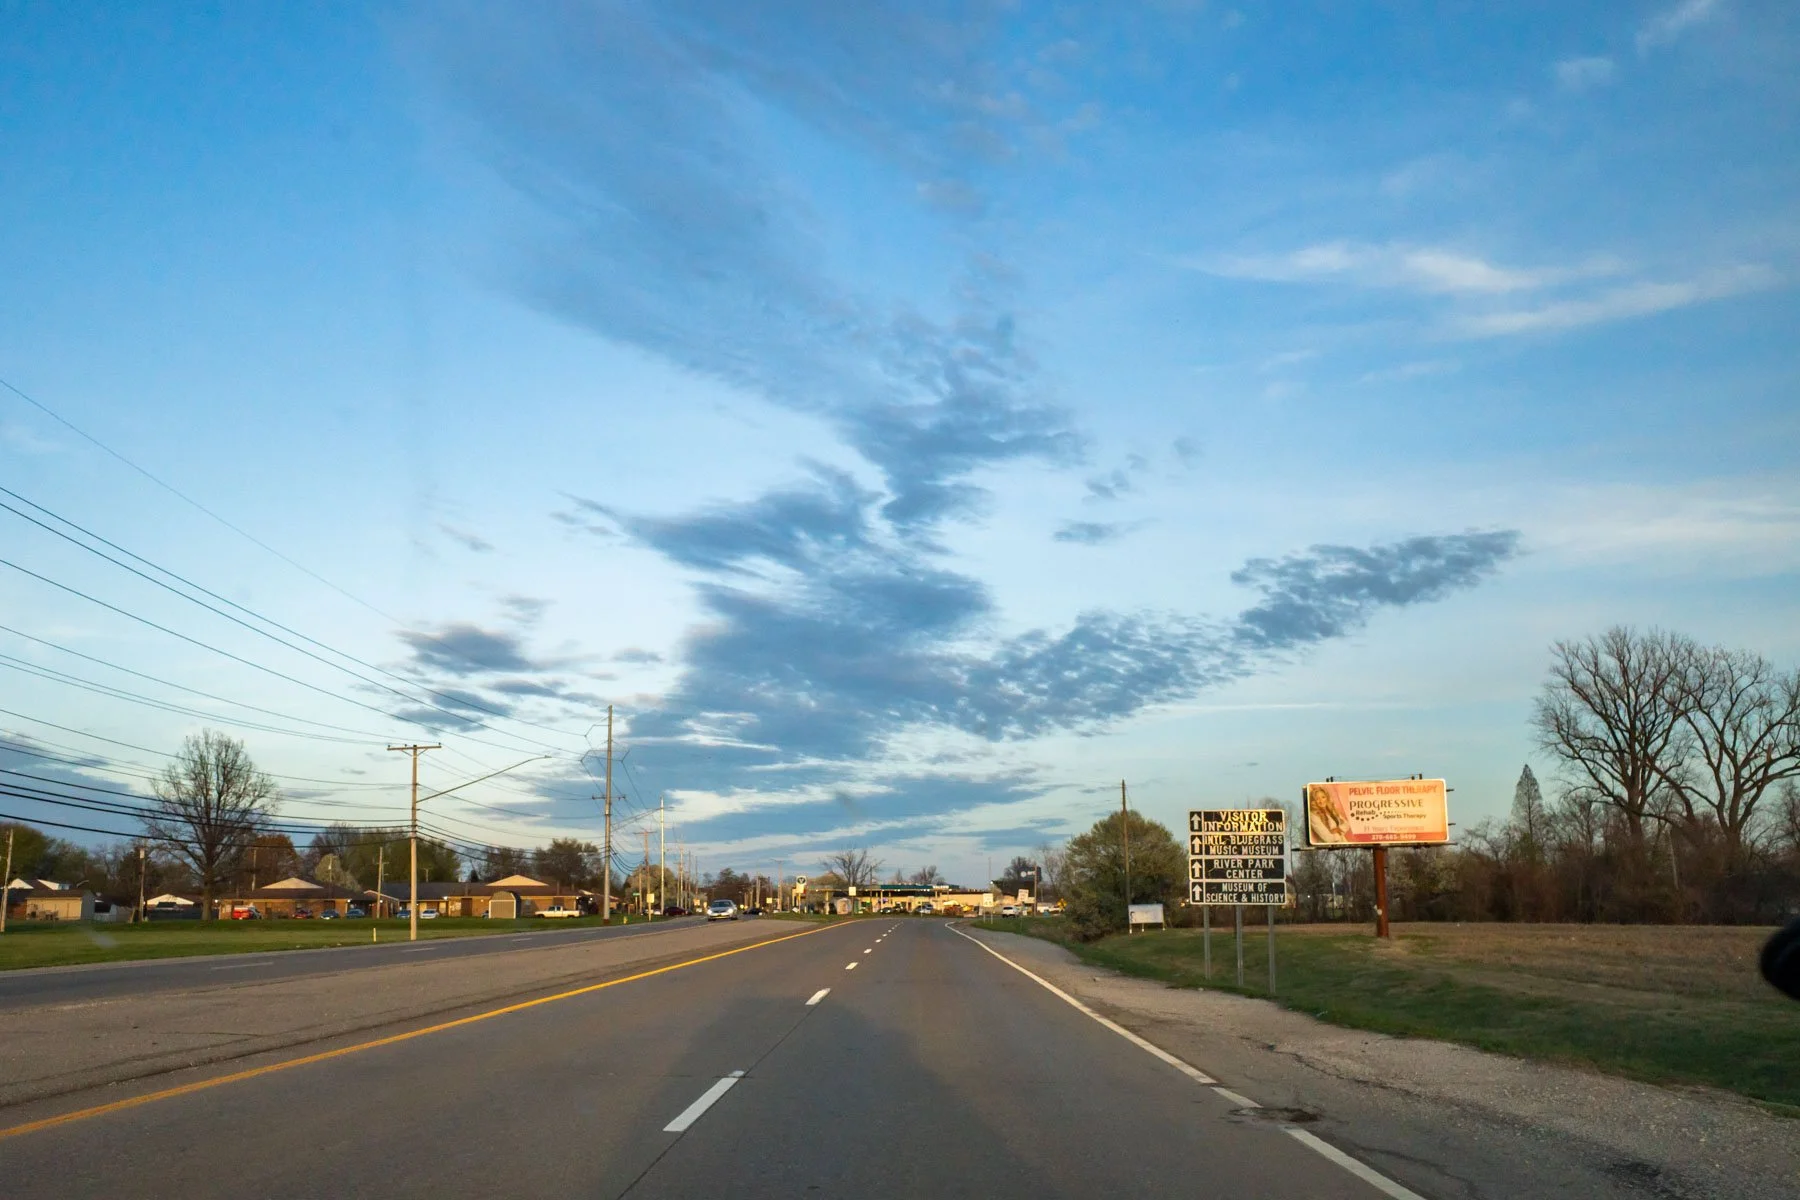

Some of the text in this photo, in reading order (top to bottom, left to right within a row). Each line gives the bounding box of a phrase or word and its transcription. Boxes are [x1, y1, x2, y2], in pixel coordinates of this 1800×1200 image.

[1349, 787, 1374, 795] PELVIC
[1350, 799, 1423, 810] PROGRESSIVE
[1220, 812, 1268, 821] VISITOR
[1205, 822, 1283, 832] INFORMATION
[1230, 836, 1283, 844] BLUEGRASS
[1210, 846, 1279, 855] MUSIC MUSEUM
[1214, 860, 1274, 868] RIVER PARK
[1226, 870, 1263, 878] CENTER
[1222, 883, 1267, 892] MUSEUM OF
[1206, 893, 1284, 902] SCIENCE & HISTORY
